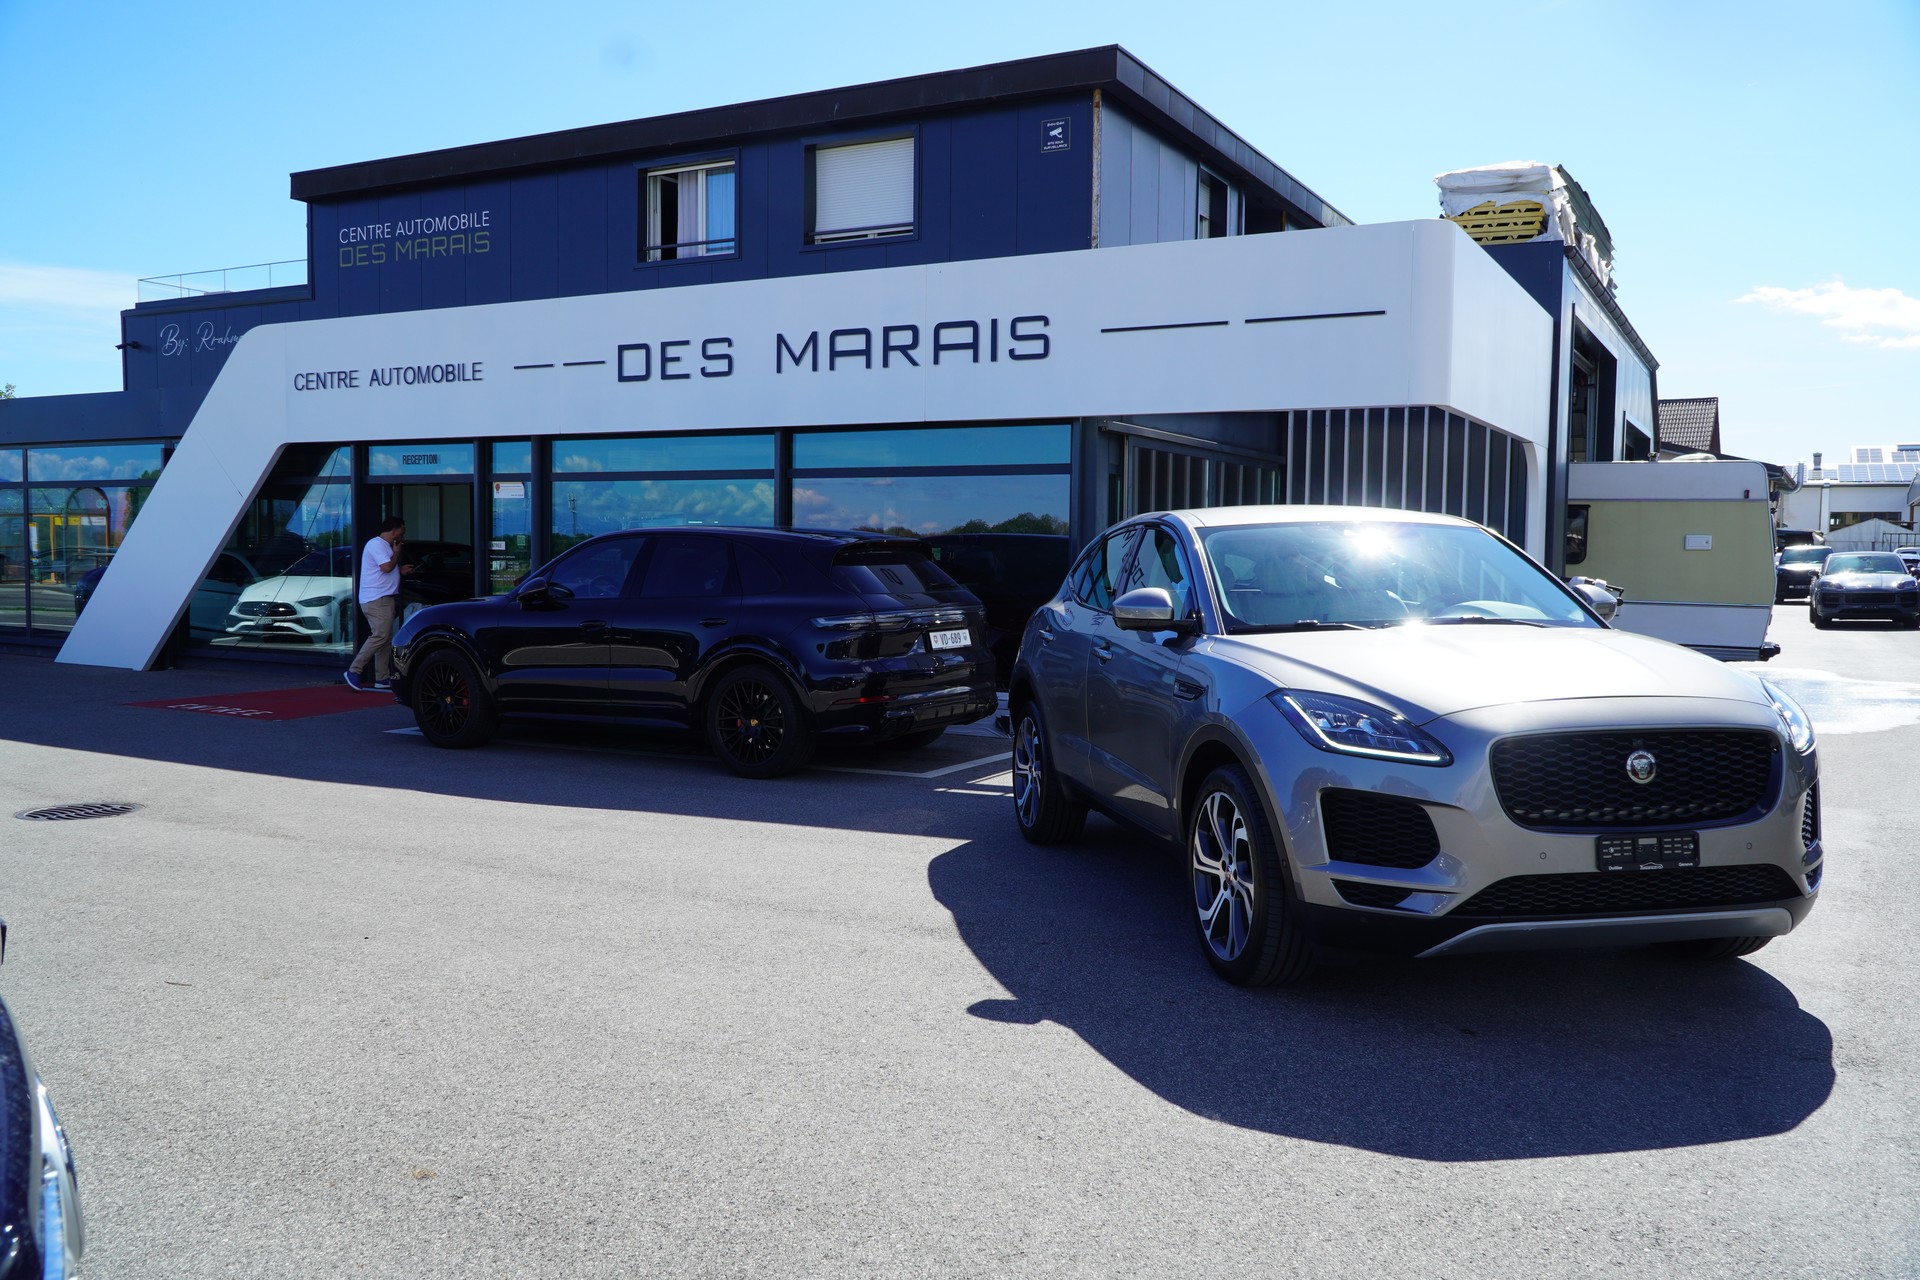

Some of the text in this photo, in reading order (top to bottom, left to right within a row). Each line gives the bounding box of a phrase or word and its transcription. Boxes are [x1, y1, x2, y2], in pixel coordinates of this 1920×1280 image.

[339, 210, 490, 244] CENTRE AUTOMOBILE
[339, 231, 490, 267] DES MARAIS
[160, 320, 242, 356] By: Rrahm
[617, 314, 1051, 383] DES MARAIS
[293, 361, 484, 392] CENTRE AUTOMOBILE
[402, 454, 438, 465] RECEPTION
[167, 703, 274, 717] ENTREE
